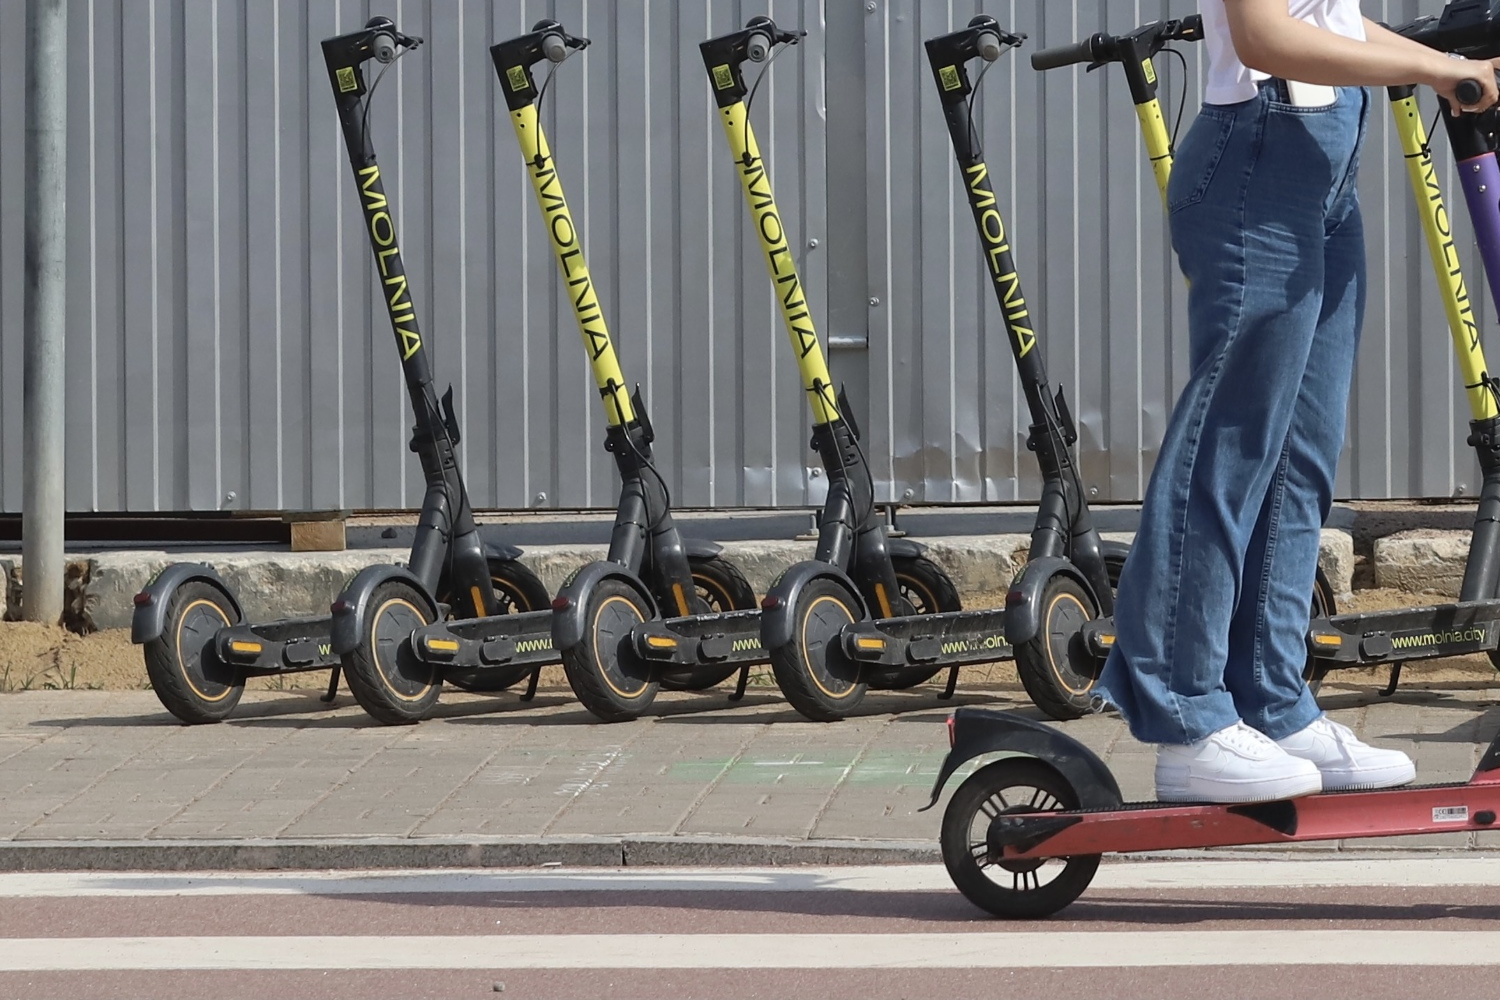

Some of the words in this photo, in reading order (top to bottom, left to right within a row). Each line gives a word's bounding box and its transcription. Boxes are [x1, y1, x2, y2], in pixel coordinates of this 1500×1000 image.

[358, 165, 421, 362] MOLNIA
[534, 167, 612, 362] MOLNIA
[742, 164, 818, 360] MOLNIA
[965, 162, 1037, 360] MOLNIA
[1420, 157, 1480, 353] MOLNIA
[1391, 626, 1485, 649] www.molnia.city
